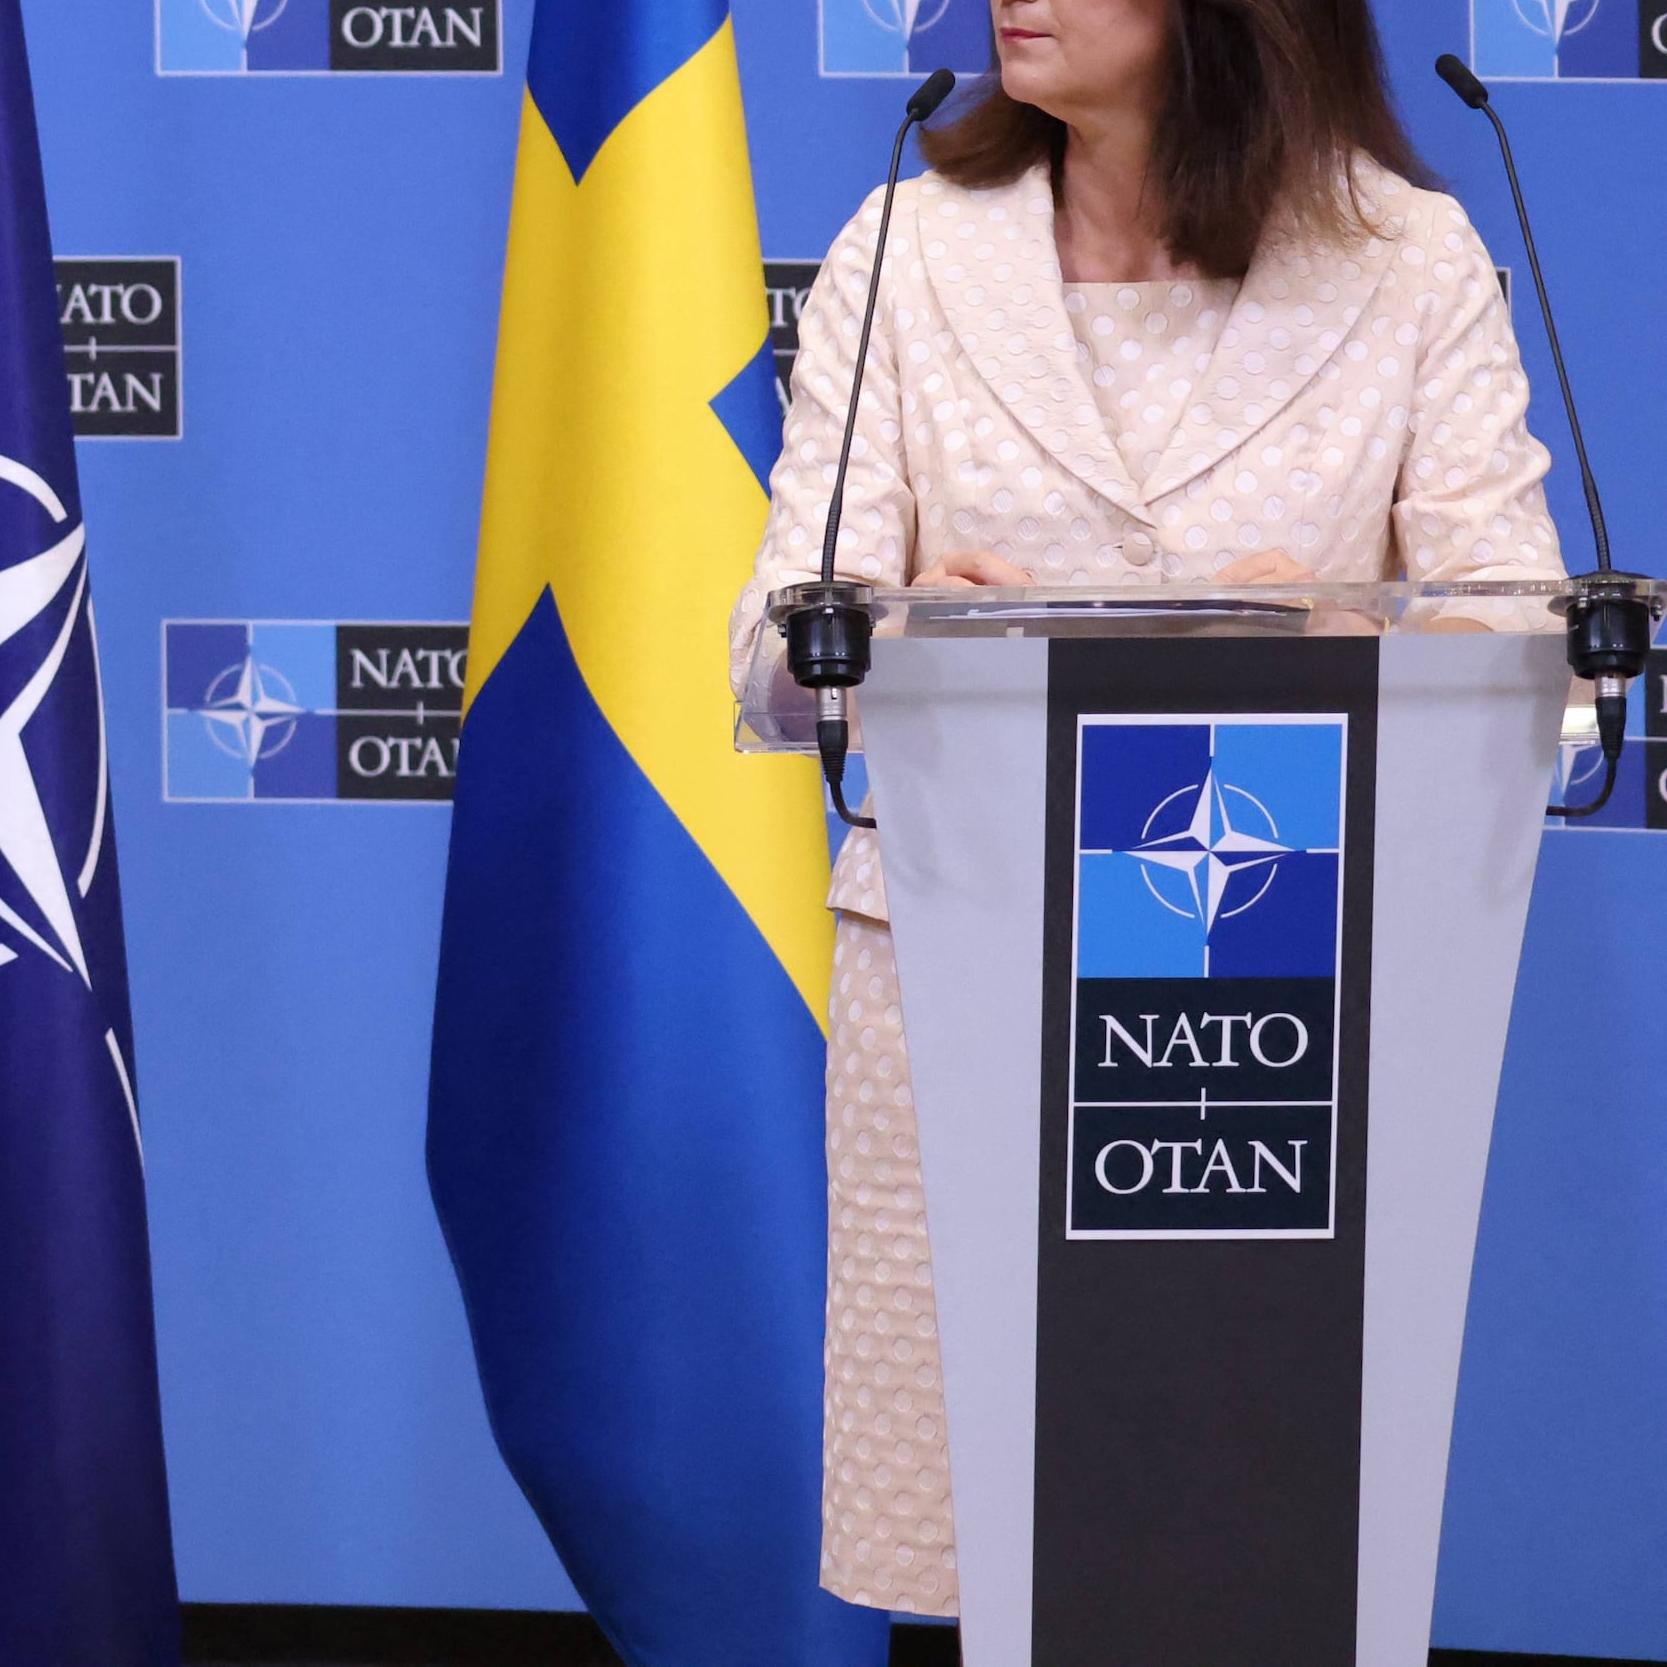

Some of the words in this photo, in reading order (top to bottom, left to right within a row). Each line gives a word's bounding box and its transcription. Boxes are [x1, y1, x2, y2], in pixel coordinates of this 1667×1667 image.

[341, 7, 483, 48] OTAN
[57, 283, 162, 325] ATO
[67, 372, 163, 412] TAN
[349, 735, 460, 778] OTA
[1097, 1011, 1309, 1068] NATO
[1094, 1138, 1309, 1195] OTAN
